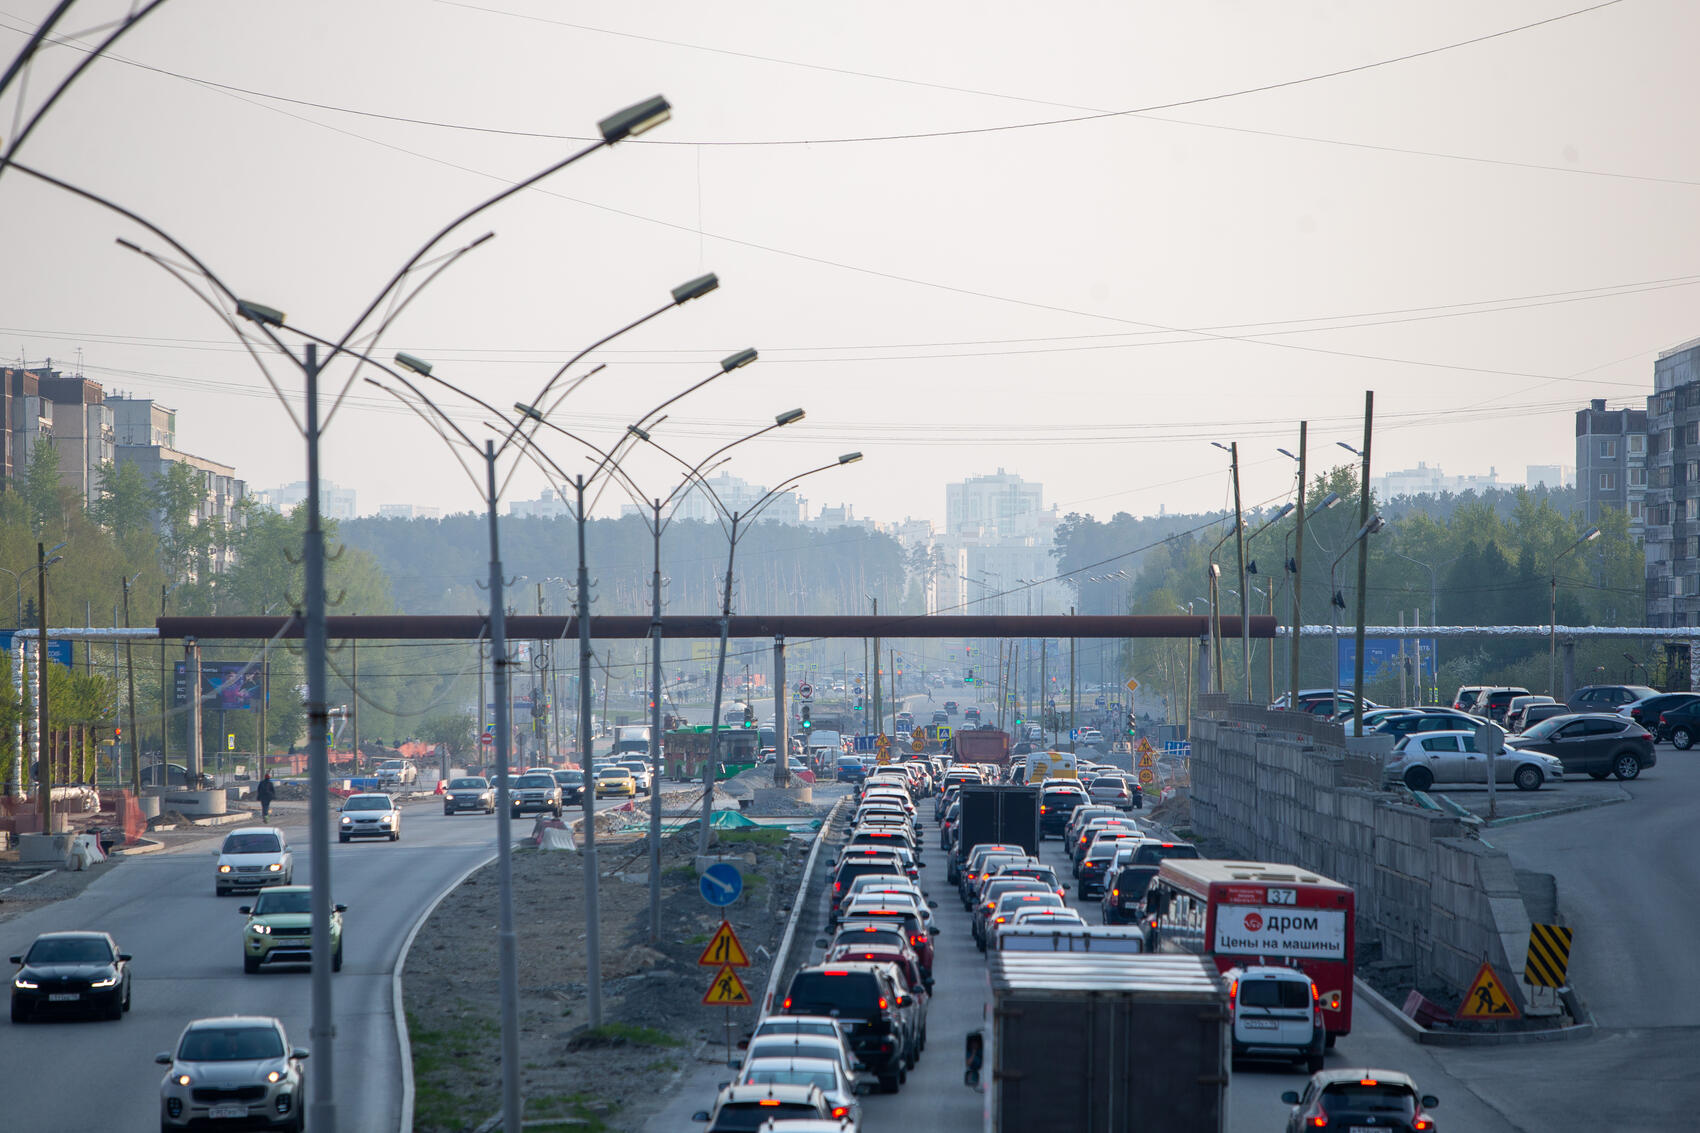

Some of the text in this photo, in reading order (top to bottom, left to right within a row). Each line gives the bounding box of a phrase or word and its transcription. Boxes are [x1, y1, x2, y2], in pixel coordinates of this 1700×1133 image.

[1271, 890, 1292, 904] 37
[1267, 916, 1318, 934] дром
[1221, 936, 1340, 951] Цены на машины
